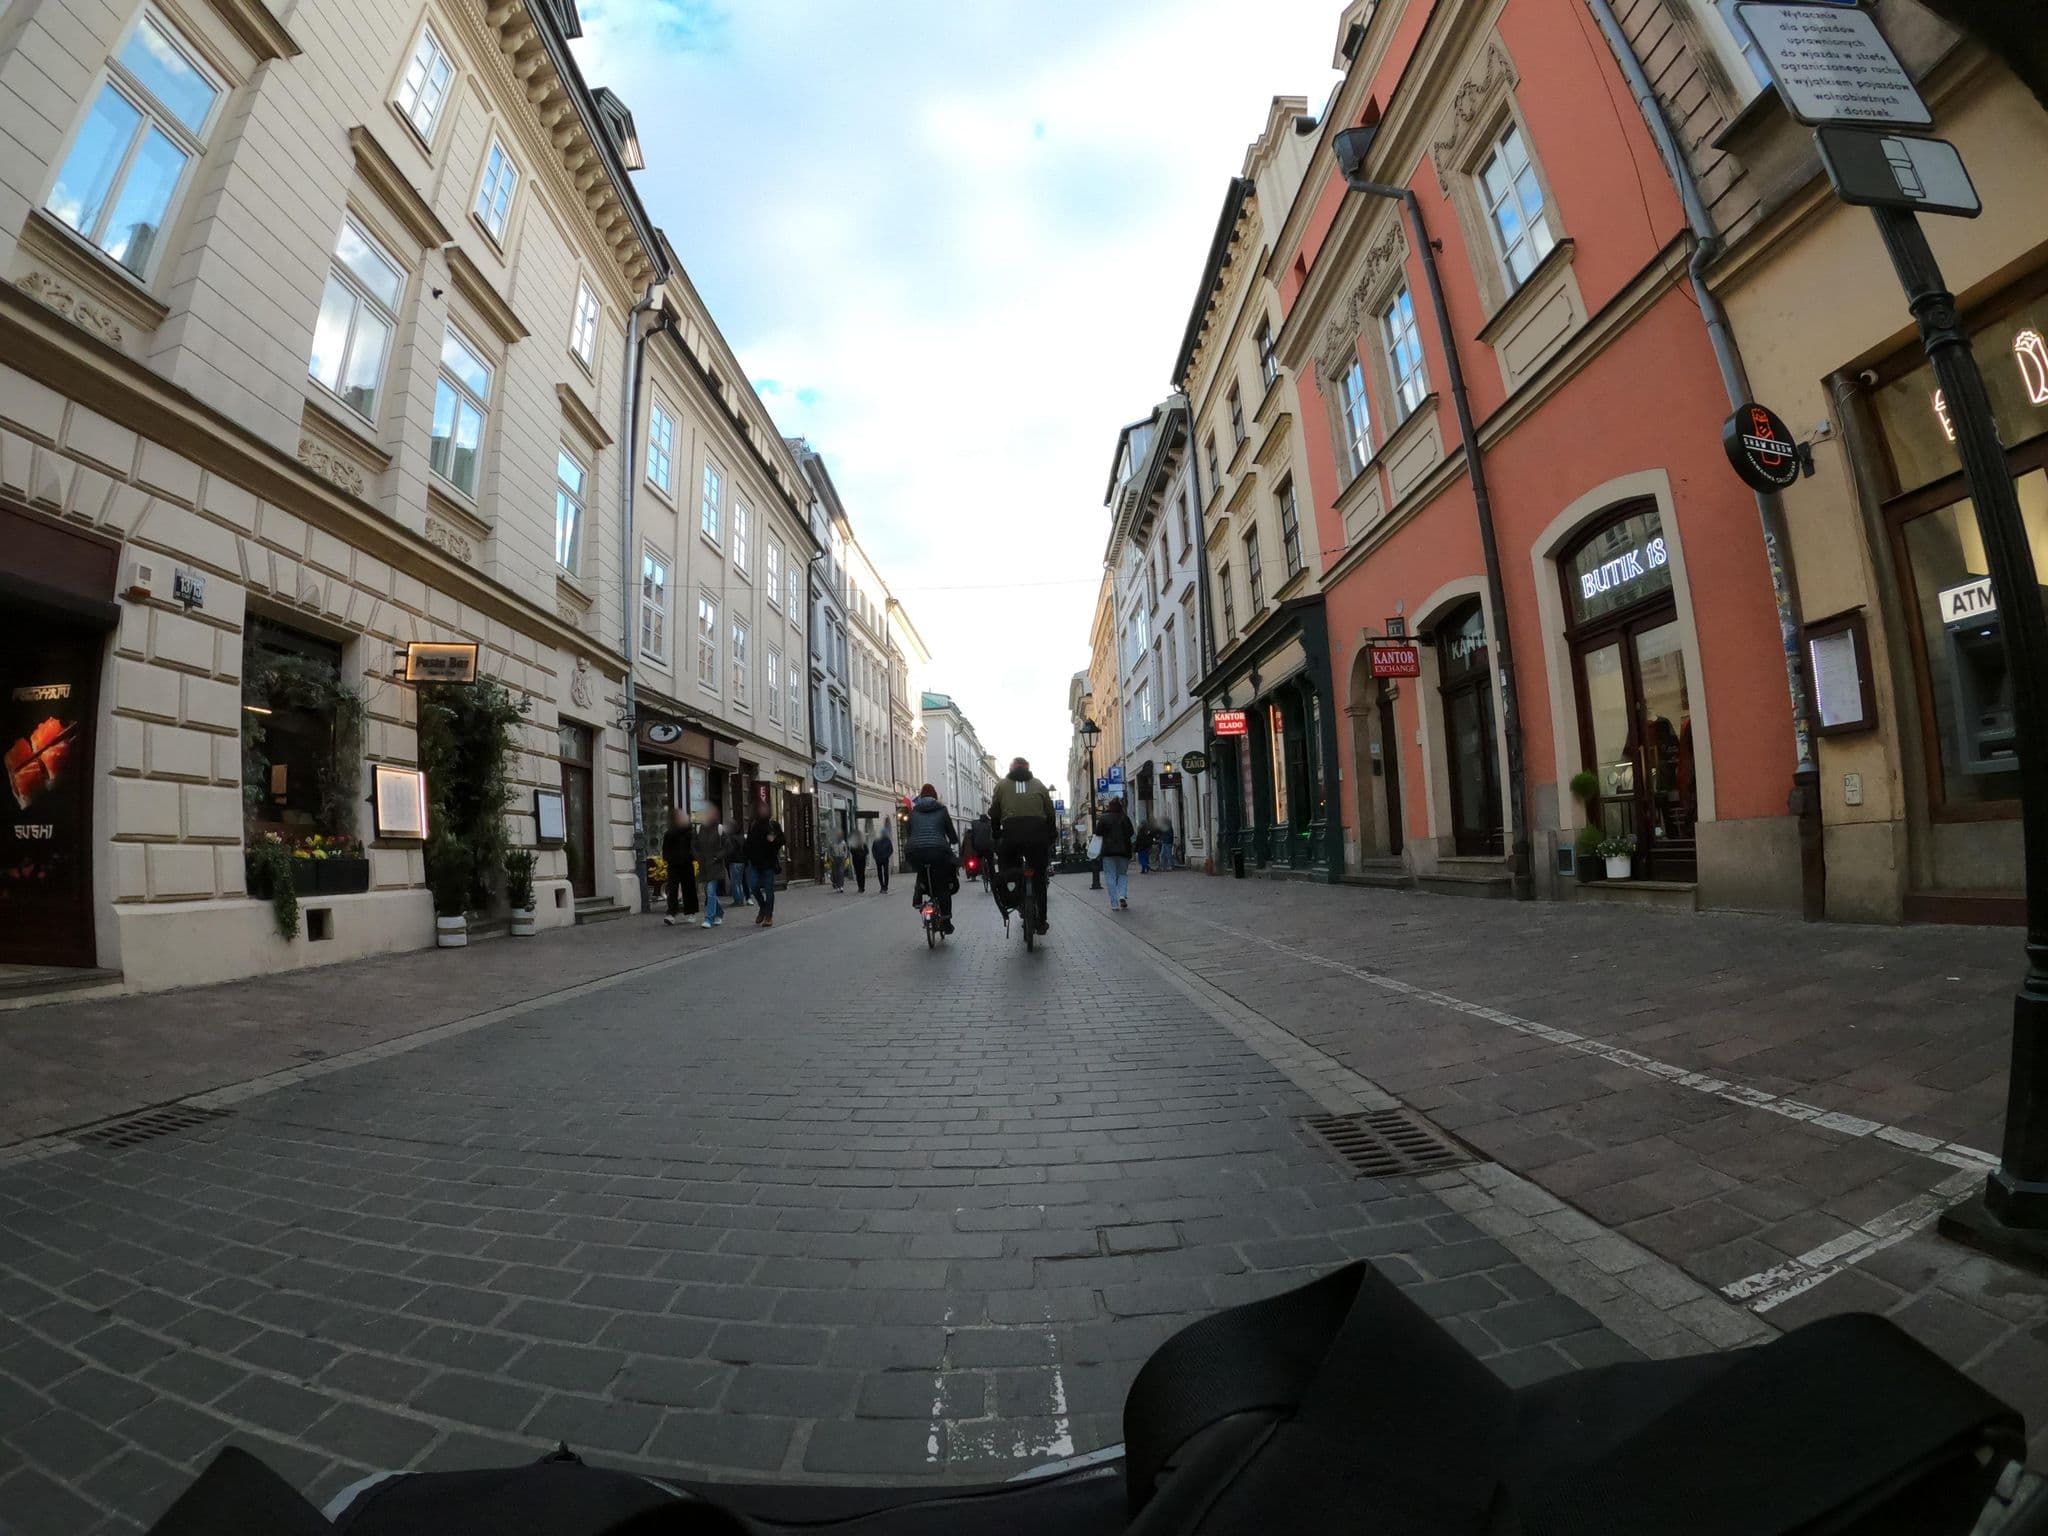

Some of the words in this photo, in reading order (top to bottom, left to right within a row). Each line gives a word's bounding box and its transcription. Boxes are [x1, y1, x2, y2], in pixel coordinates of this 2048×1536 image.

[1581, 549, 1644, 599] BUTIK
[1646, 538, 1667, 569] 18
[1953, 583, 1995, 615] ATM
[1373, 651, 1415, 664] KANTOR
[1374, 664, 1417, 673] EXCHANGE
[1214, 712, 1246, 721] KANTOR
[14, 825, 54, 839] SUSHI
